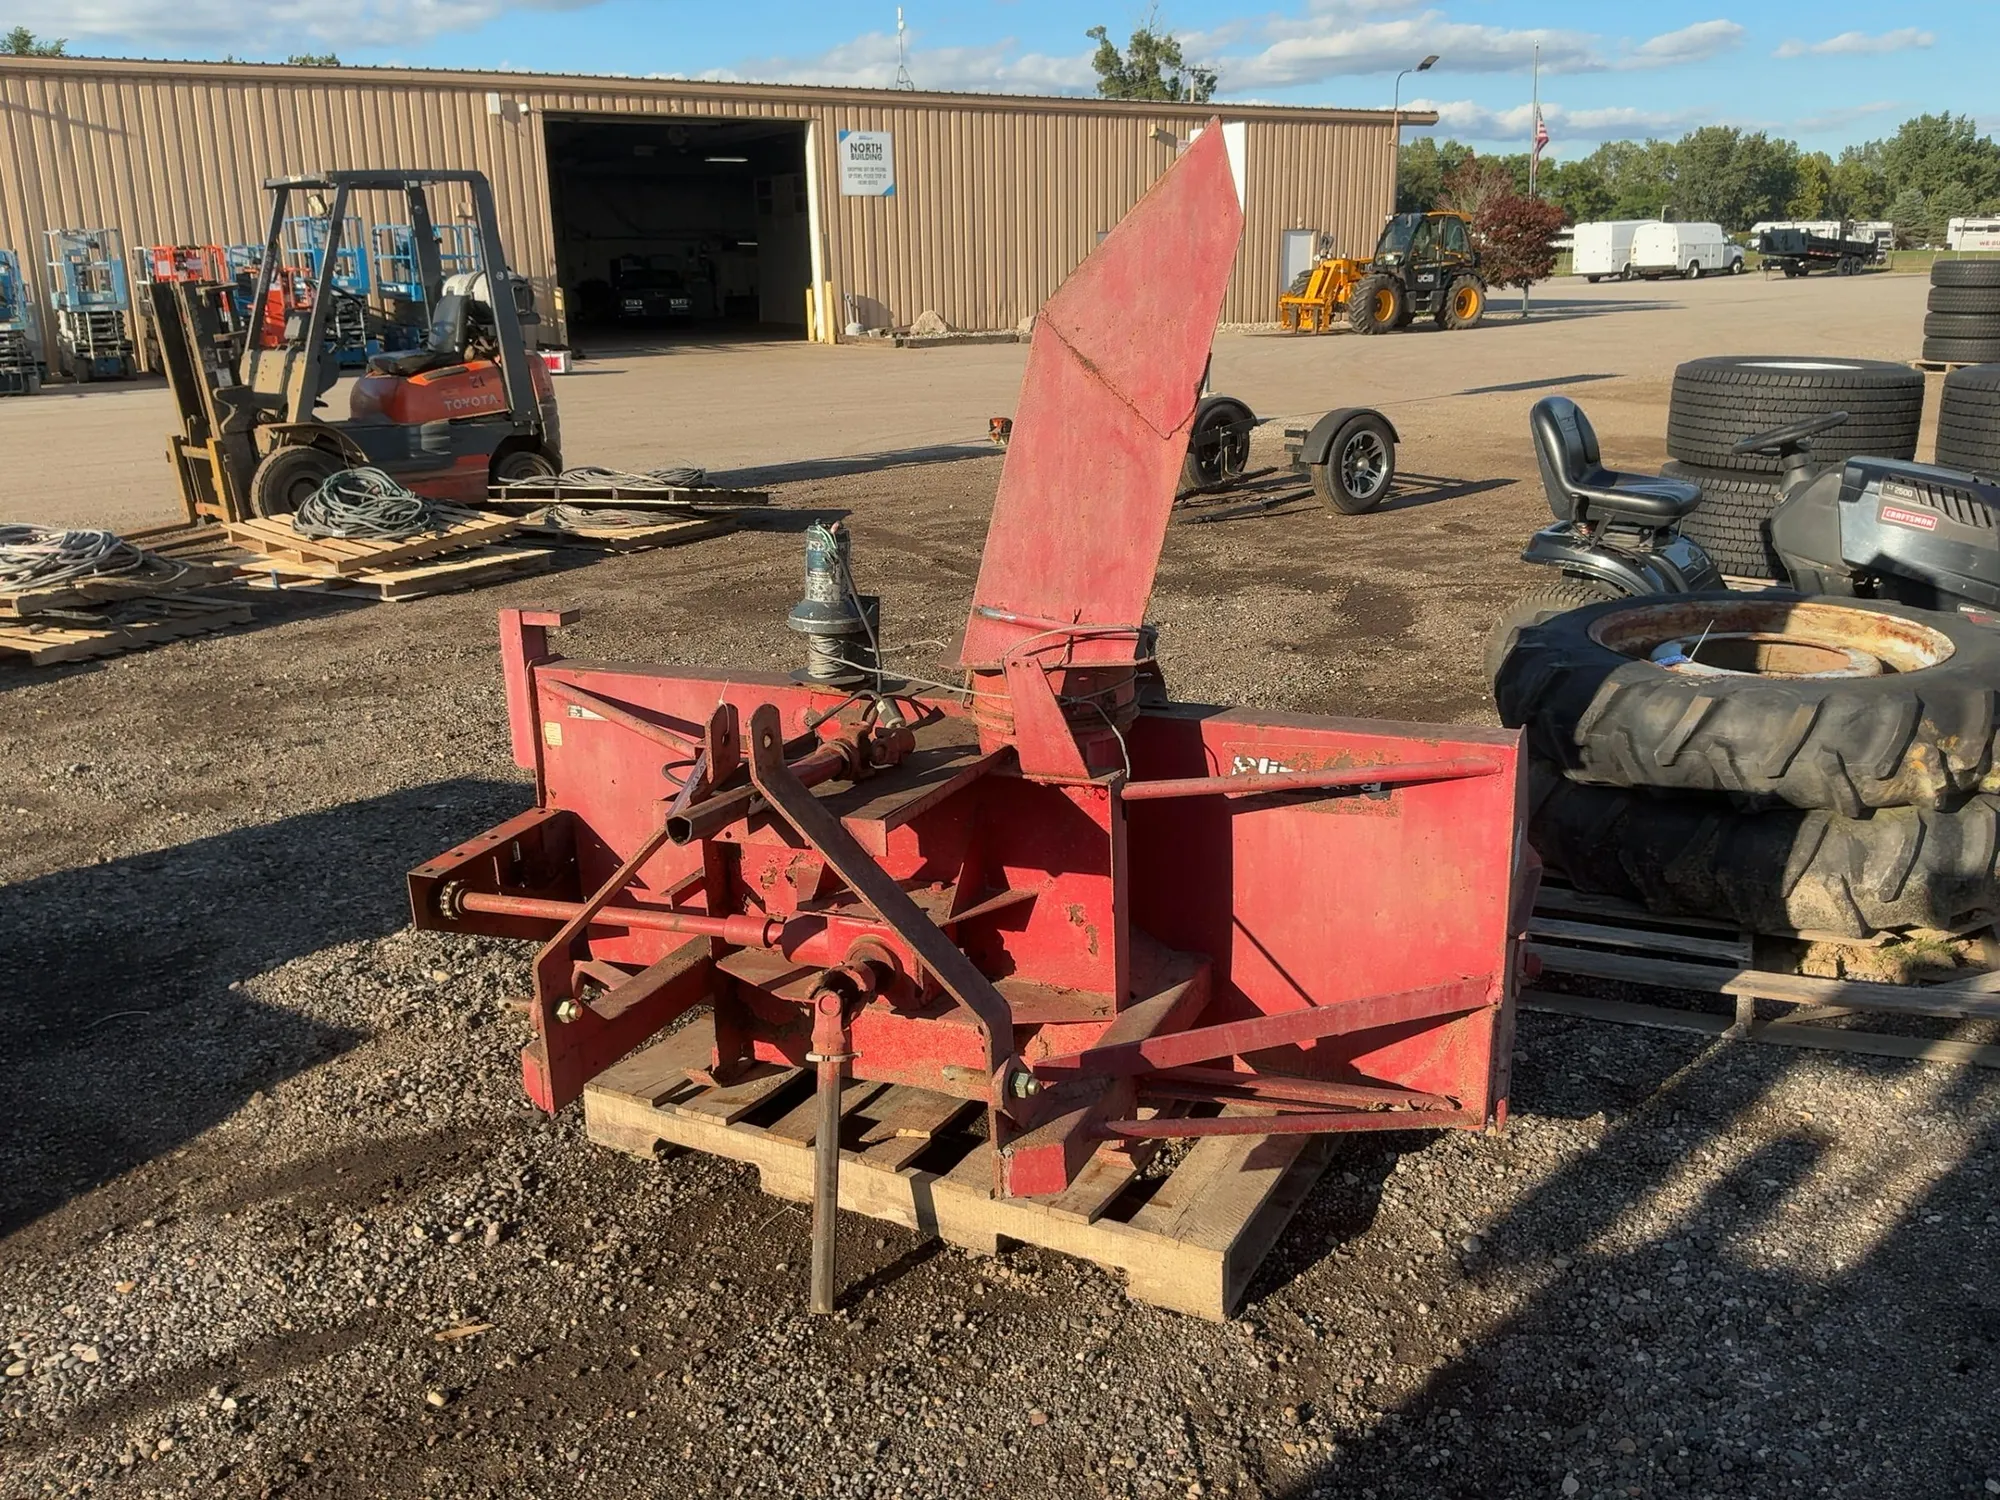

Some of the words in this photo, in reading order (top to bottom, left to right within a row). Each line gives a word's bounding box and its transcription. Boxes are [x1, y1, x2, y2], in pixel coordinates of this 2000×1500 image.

[850, 143, 883, 153] NORTH
[850, 153, 883, 161] BUILDING
[1417, 274, 1435, 283] JCB
[444, 394, 498, 411] TOYOTA
[1894, 485, 1913, 498] 2500
[1885, 509, 1935, 527] CRAFTSMAN
